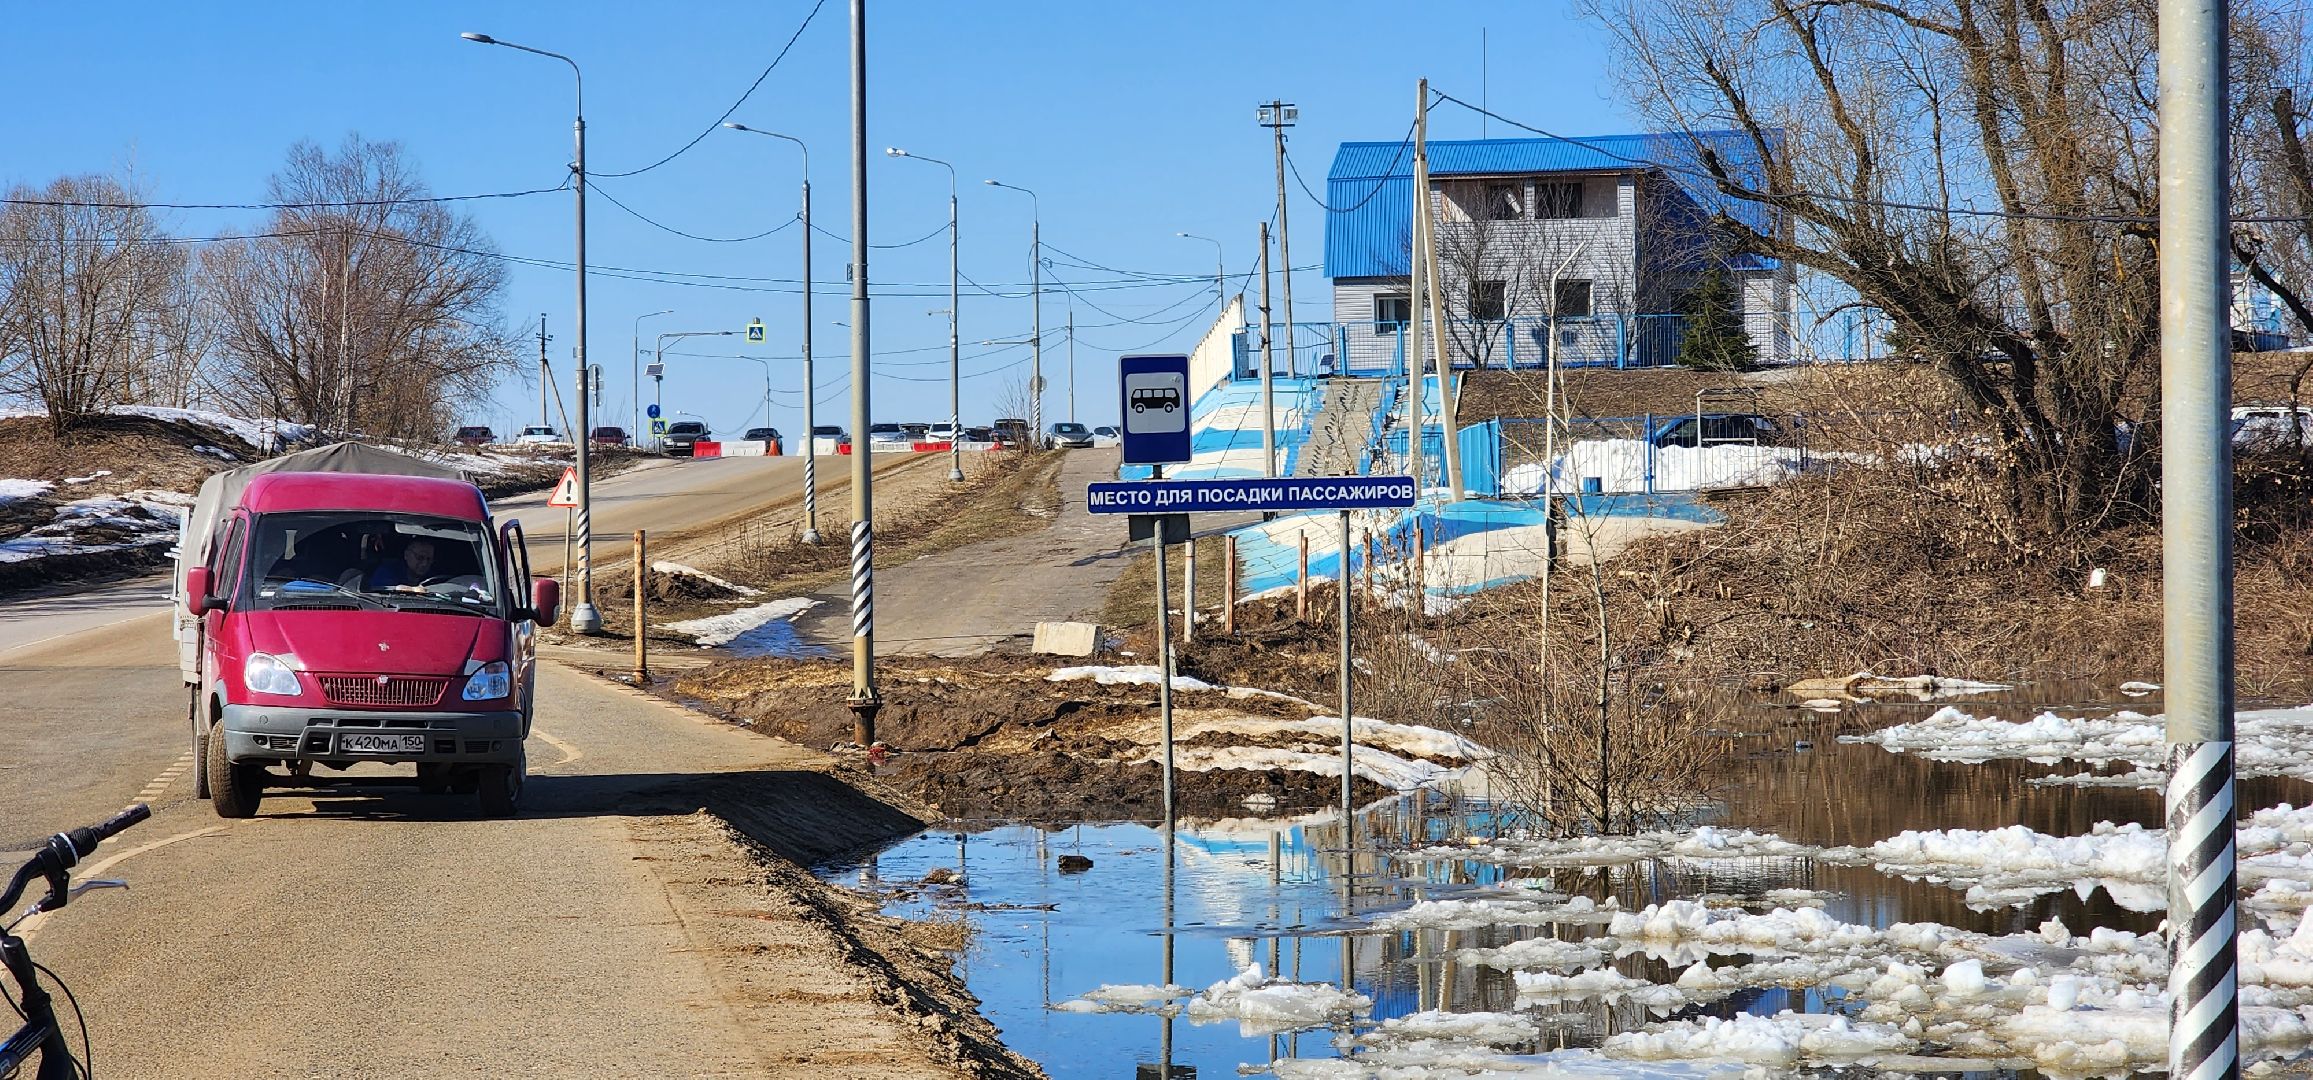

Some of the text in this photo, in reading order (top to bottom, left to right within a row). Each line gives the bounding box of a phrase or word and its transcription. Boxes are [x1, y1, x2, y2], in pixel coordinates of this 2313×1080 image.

[1090, 485, 1414, 507] МЕСТО ДЛЯ ПОСАДКИ ПАССАЖИРОВ
[345, 736, 398, 750] К420МА
[402, 736, 421, 746] 150
